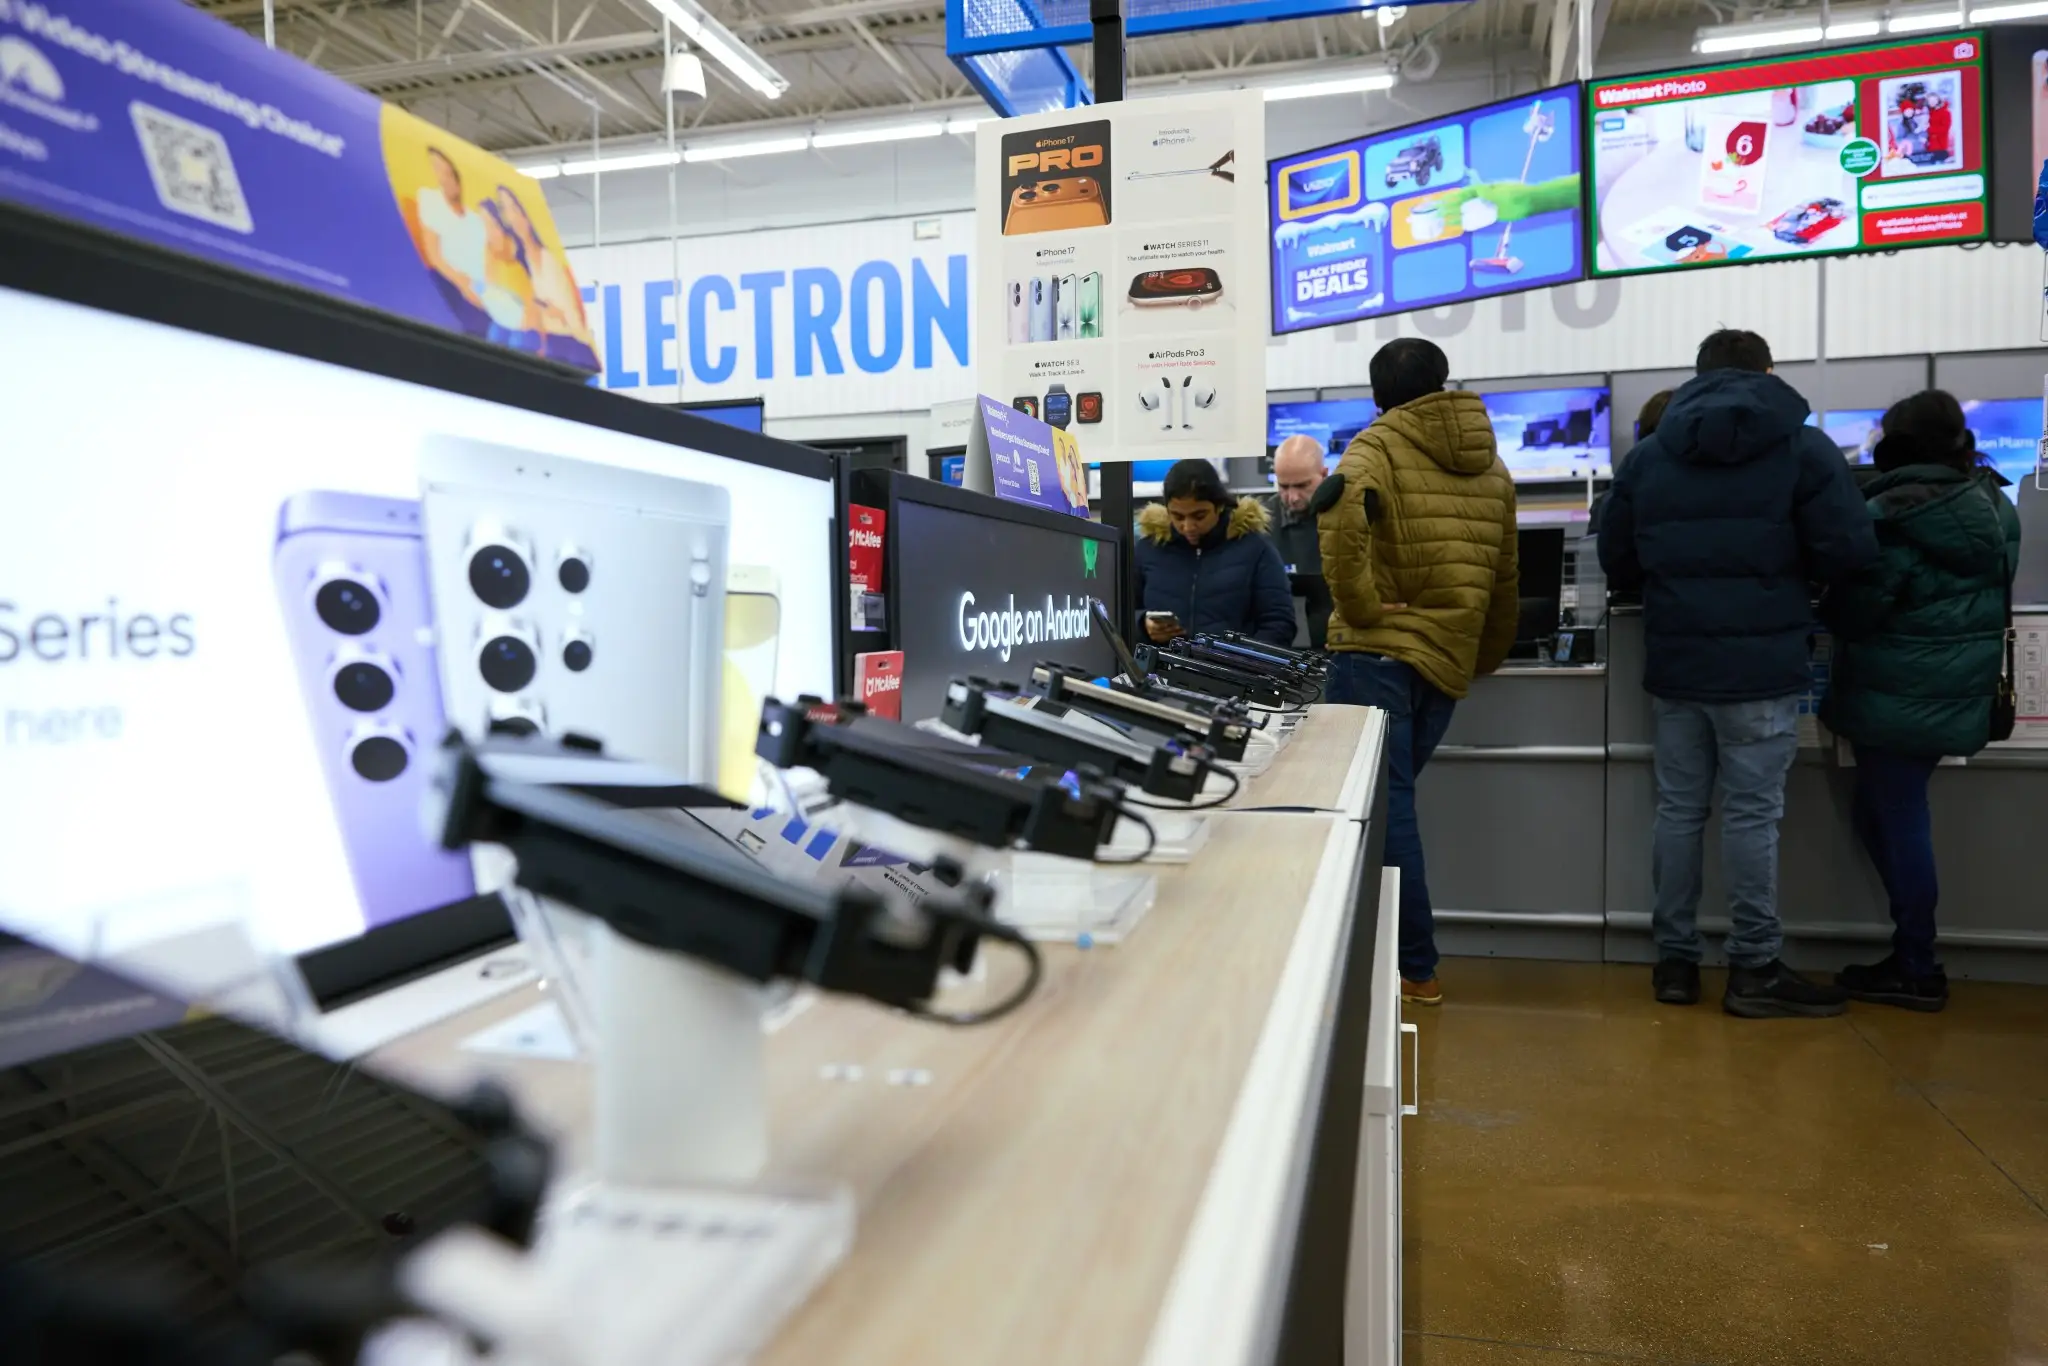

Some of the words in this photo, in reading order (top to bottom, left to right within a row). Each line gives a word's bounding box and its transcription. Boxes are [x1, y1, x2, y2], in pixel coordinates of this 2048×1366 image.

[1600, 83, 1664, 104] Walmart
[1664, 80, 1706, 96] Photo
[1041, 137, 1067, 148] iPhone
[1068, 136, 1075, 145] 17
[1158, 136, 1186, 146] iPhone
[1736, 134, 1753, 155] 6
[1008, 144, 1103, 177] PRO
[1303, 176, 1335, 192] VIZIO
[1042, 248, 1067, 257] iPhone
[1149, 242, 1176, 250] WATCH
[1177, 240, 1202, 248] SERIES
[1307, 237, 1356, 258] Walmart
[1296, 265, 1330, 282] BLACK
[1330, 257, 1368, 274] FRIDAY
[1296, 269, 1368, 302] DEALS
[1155, 350, 1185, 359] AirPods
[1185, 349, 1199, 357] Pro
[1199, 348, 1205, 357] 3
[1041, 361, 1065, 369] WATCH
[855, 529, 882, 548] McAfee
[0, 595, 195, 663] Series
[959, 591, 1024, 663] Google
[1025, 610, 1044, 644] on
[1045, 594, 1091, 642] Android
[873, 674, 900, 694] McAfee
